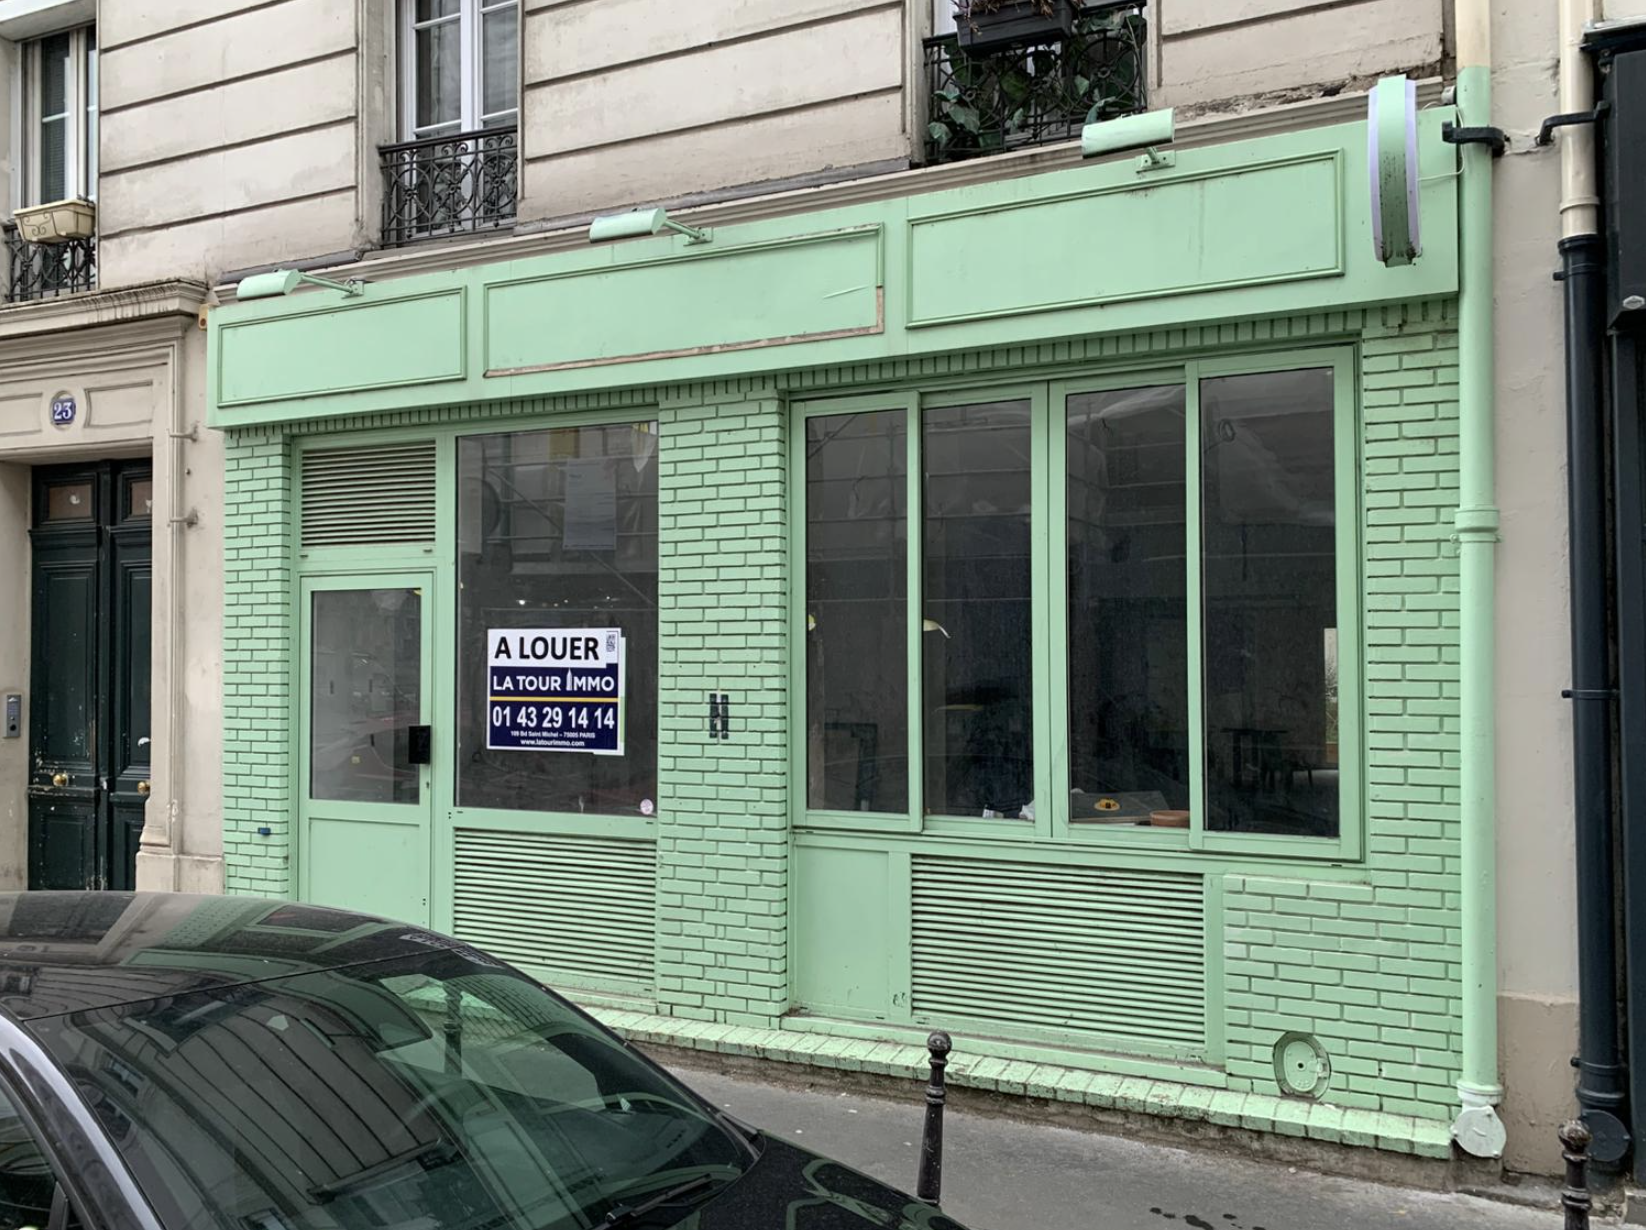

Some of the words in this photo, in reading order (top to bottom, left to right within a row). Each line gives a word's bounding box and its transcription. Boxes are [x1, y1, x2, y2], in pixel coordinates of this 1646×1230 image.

[54, 401, 73, 420] 23
[494, 636, 512, 659] A
[519, 636, 600, 661] LOUER
[493, 675, 515, 691] LA
[516, 675, 562, 691] TOUR
[565, 668, 615, 692] IMMO
[492, 705, 511, 727] 01
[516, 706, 538, 728] 43
[541, 706, 563, 729] 29
[568, 706, 589, 729] 14
[594, 707, 615, 729] 14
[520, 738, 585, 747] www.latourimmo.com
